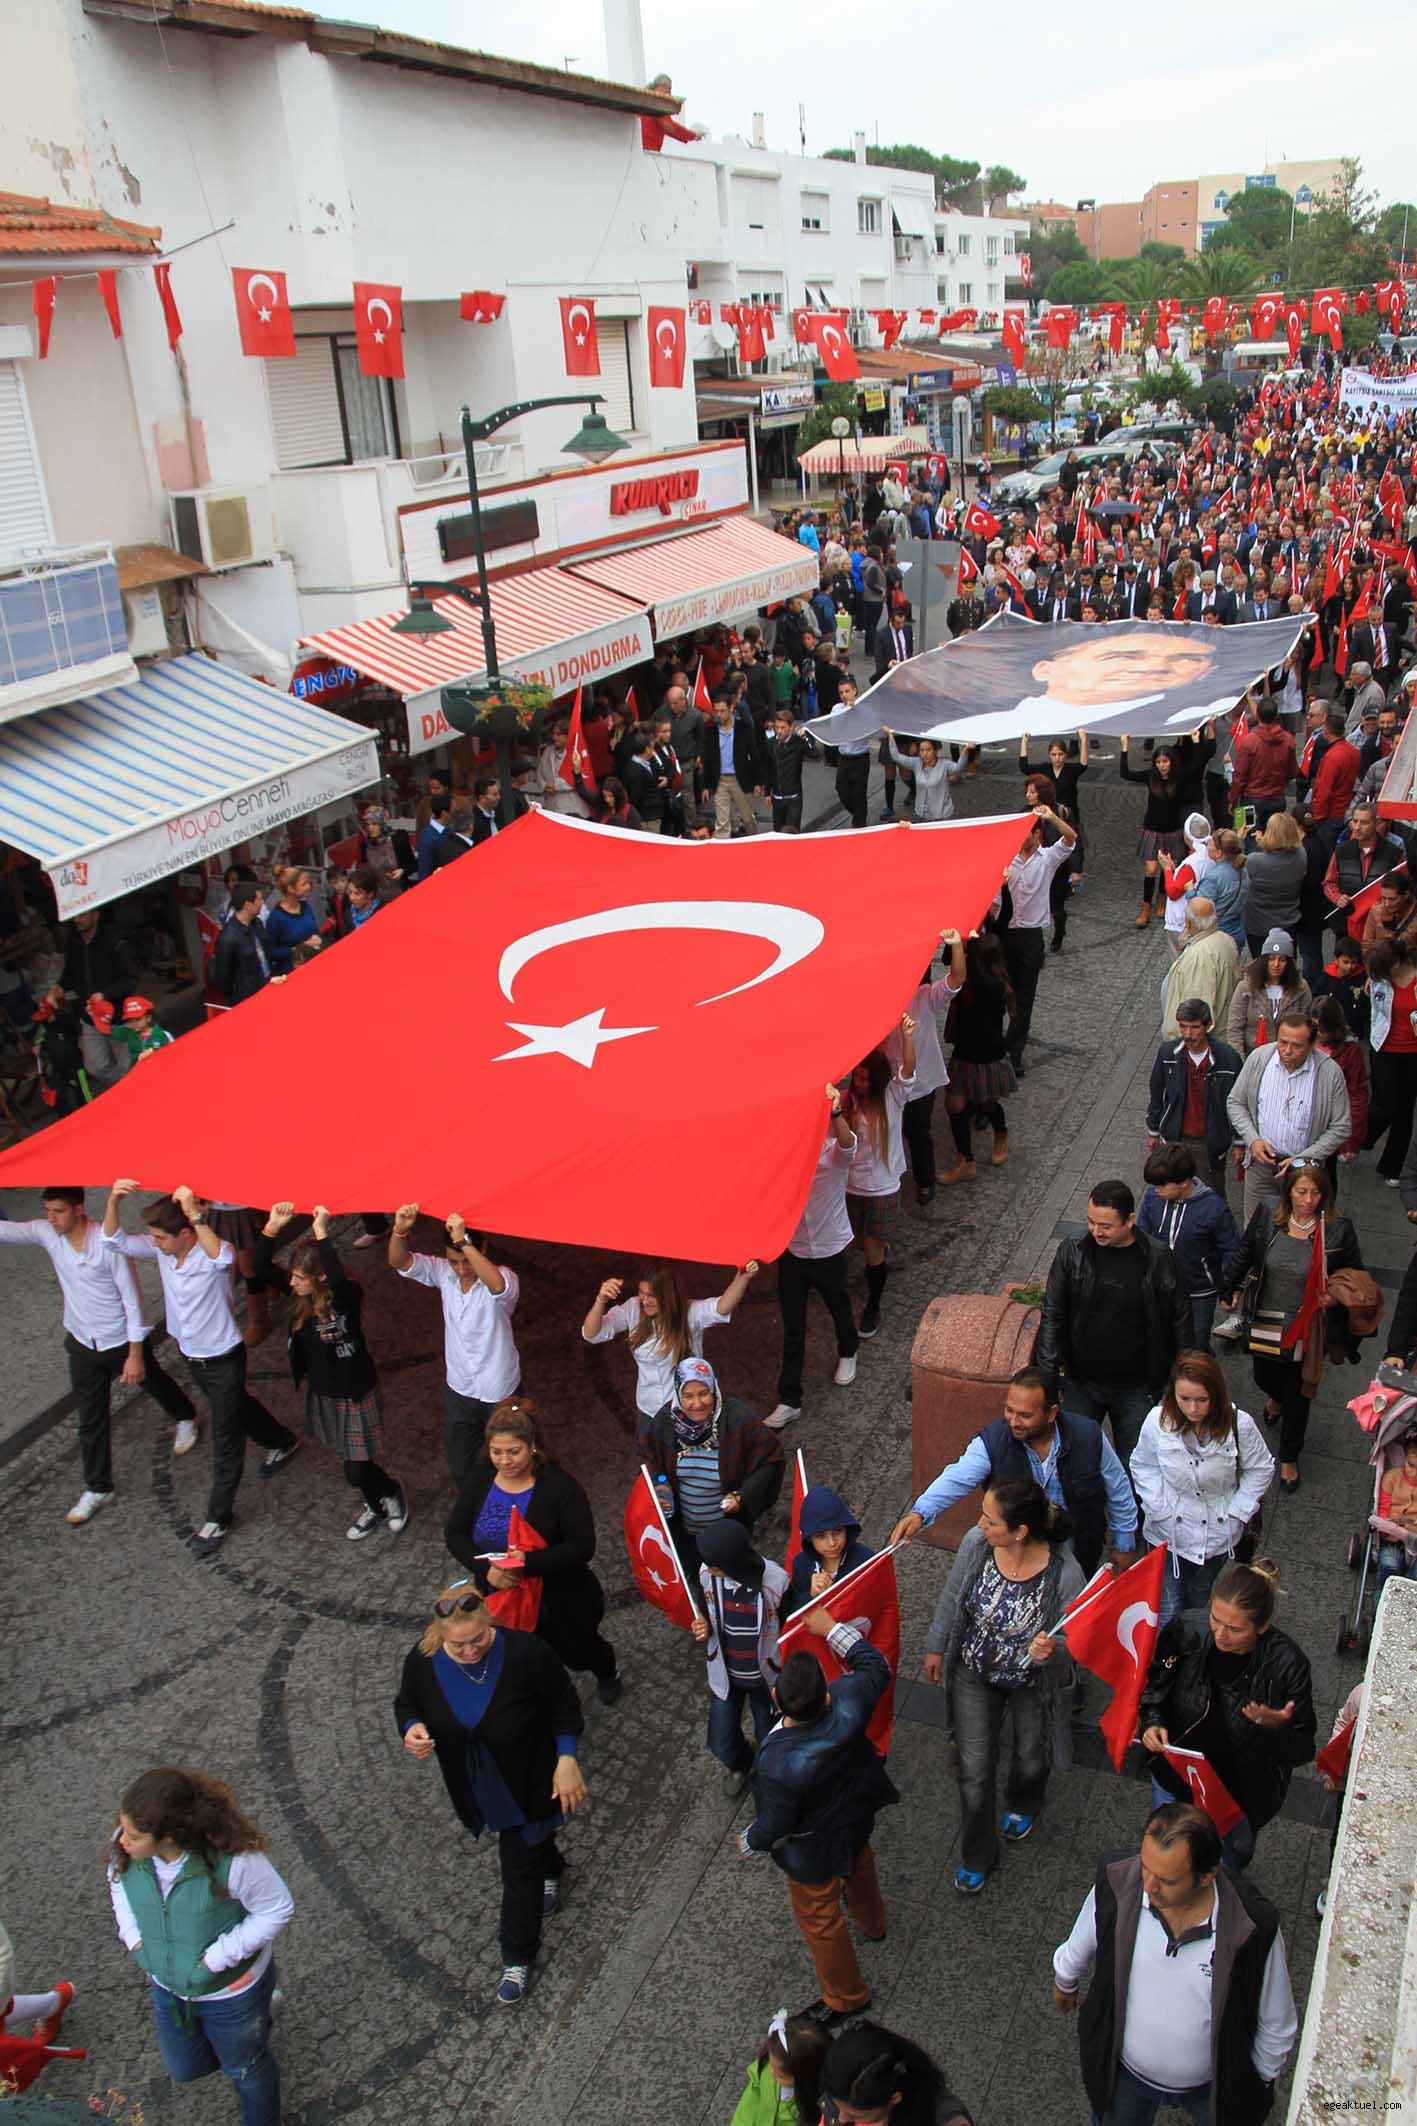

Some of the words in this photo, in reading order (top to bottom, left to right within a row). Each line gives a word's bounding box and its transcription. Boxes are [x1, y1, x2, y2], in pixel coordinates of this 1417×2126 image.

[610, 468, 700, 516] KUMRUCU
[557, 633, 641, 683] DONDURMA
[267, 807, 291, 825] MAYO
